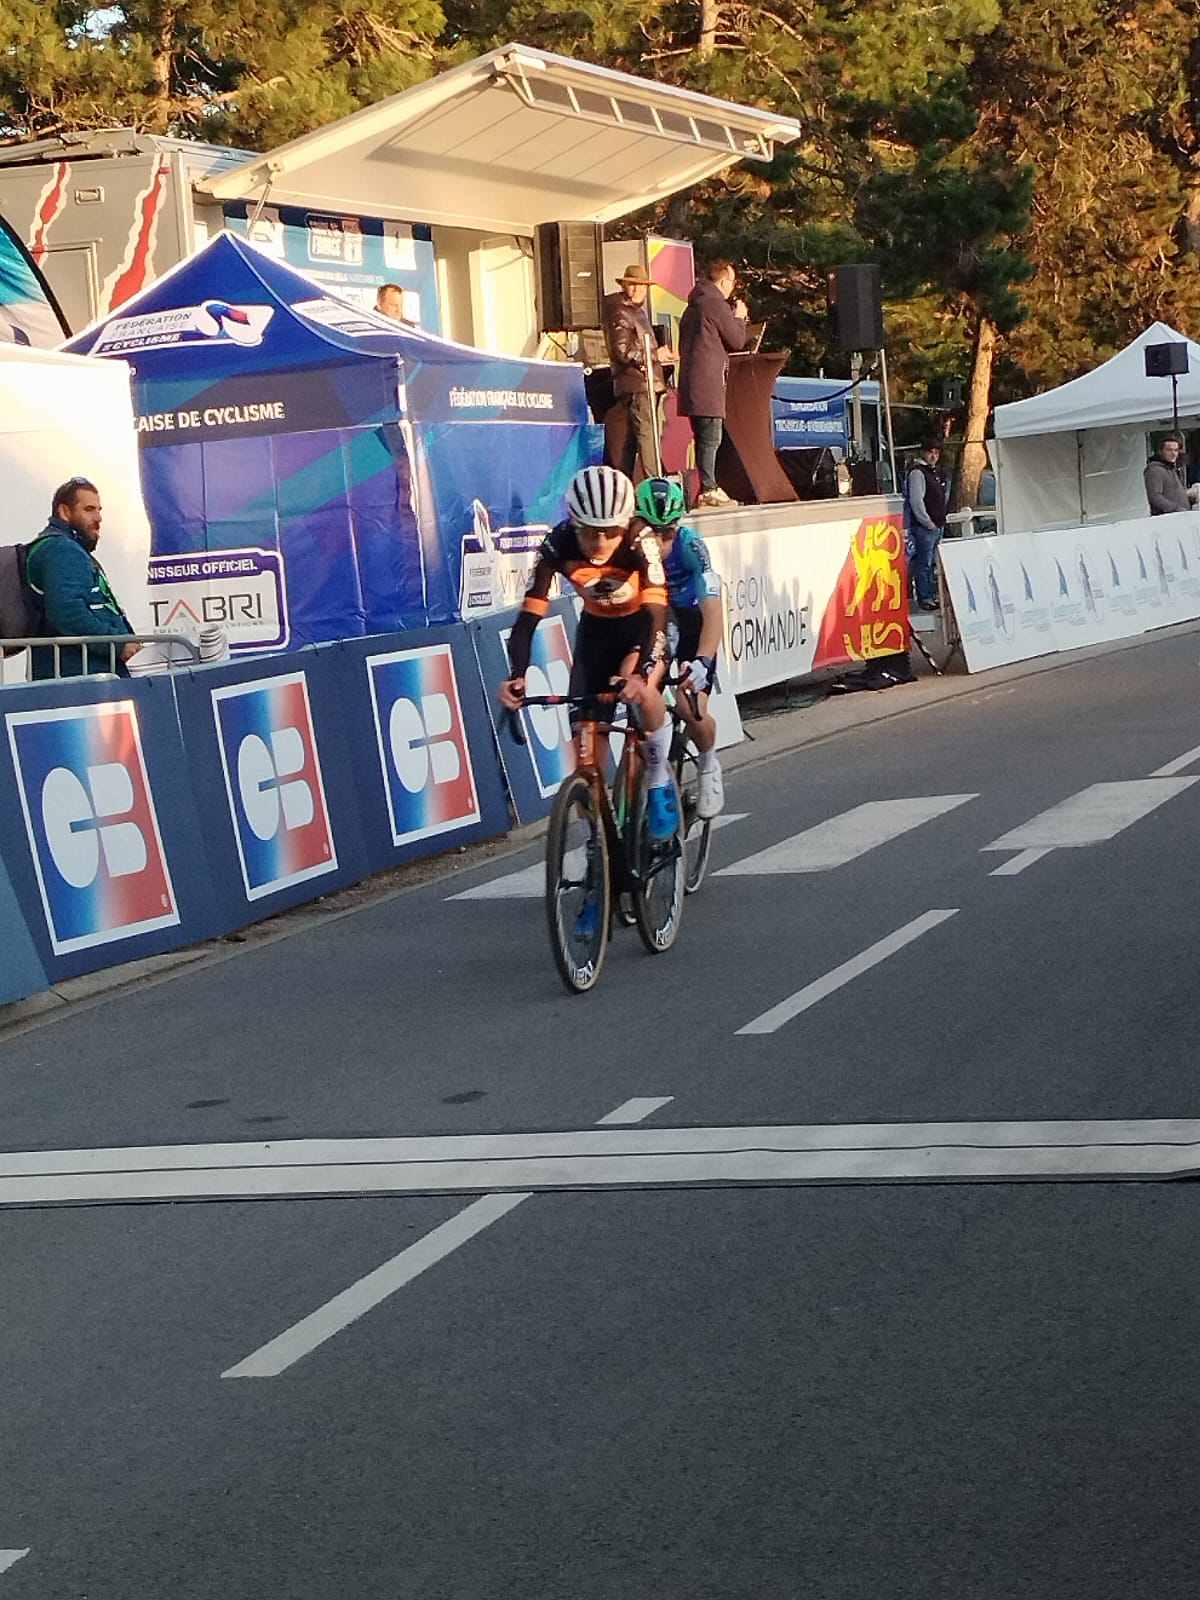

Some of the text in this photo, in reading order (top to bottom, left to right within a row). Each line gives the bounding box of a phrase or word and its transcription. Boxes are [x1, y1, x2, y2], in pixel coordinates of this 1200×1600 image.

[178, 410, 202, 429] DE
[203, 401, 286, 426] CYCLISME
[202, 558, 259, 573] OFFICIEL
[730, 605, 809, 662] ORMANDIE
